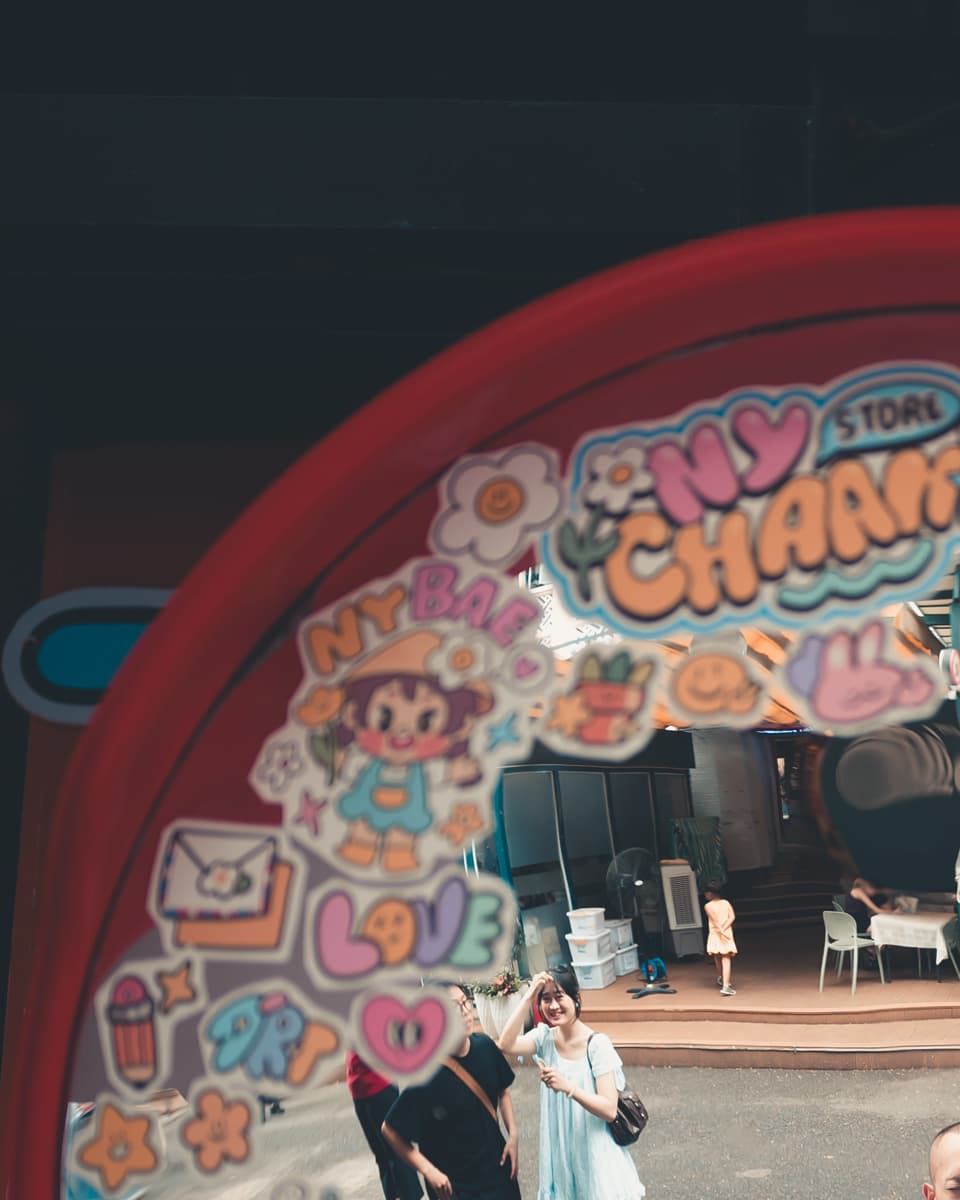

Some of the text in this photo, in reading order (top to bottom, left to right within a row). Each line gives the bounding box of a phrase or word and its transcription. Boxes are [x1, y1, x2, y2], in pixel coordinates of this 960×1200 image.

[647, 404, 812, 524] NY
[308, 563, 539, 674] NY BAE
[315, 876, 503, 978] LOVE
